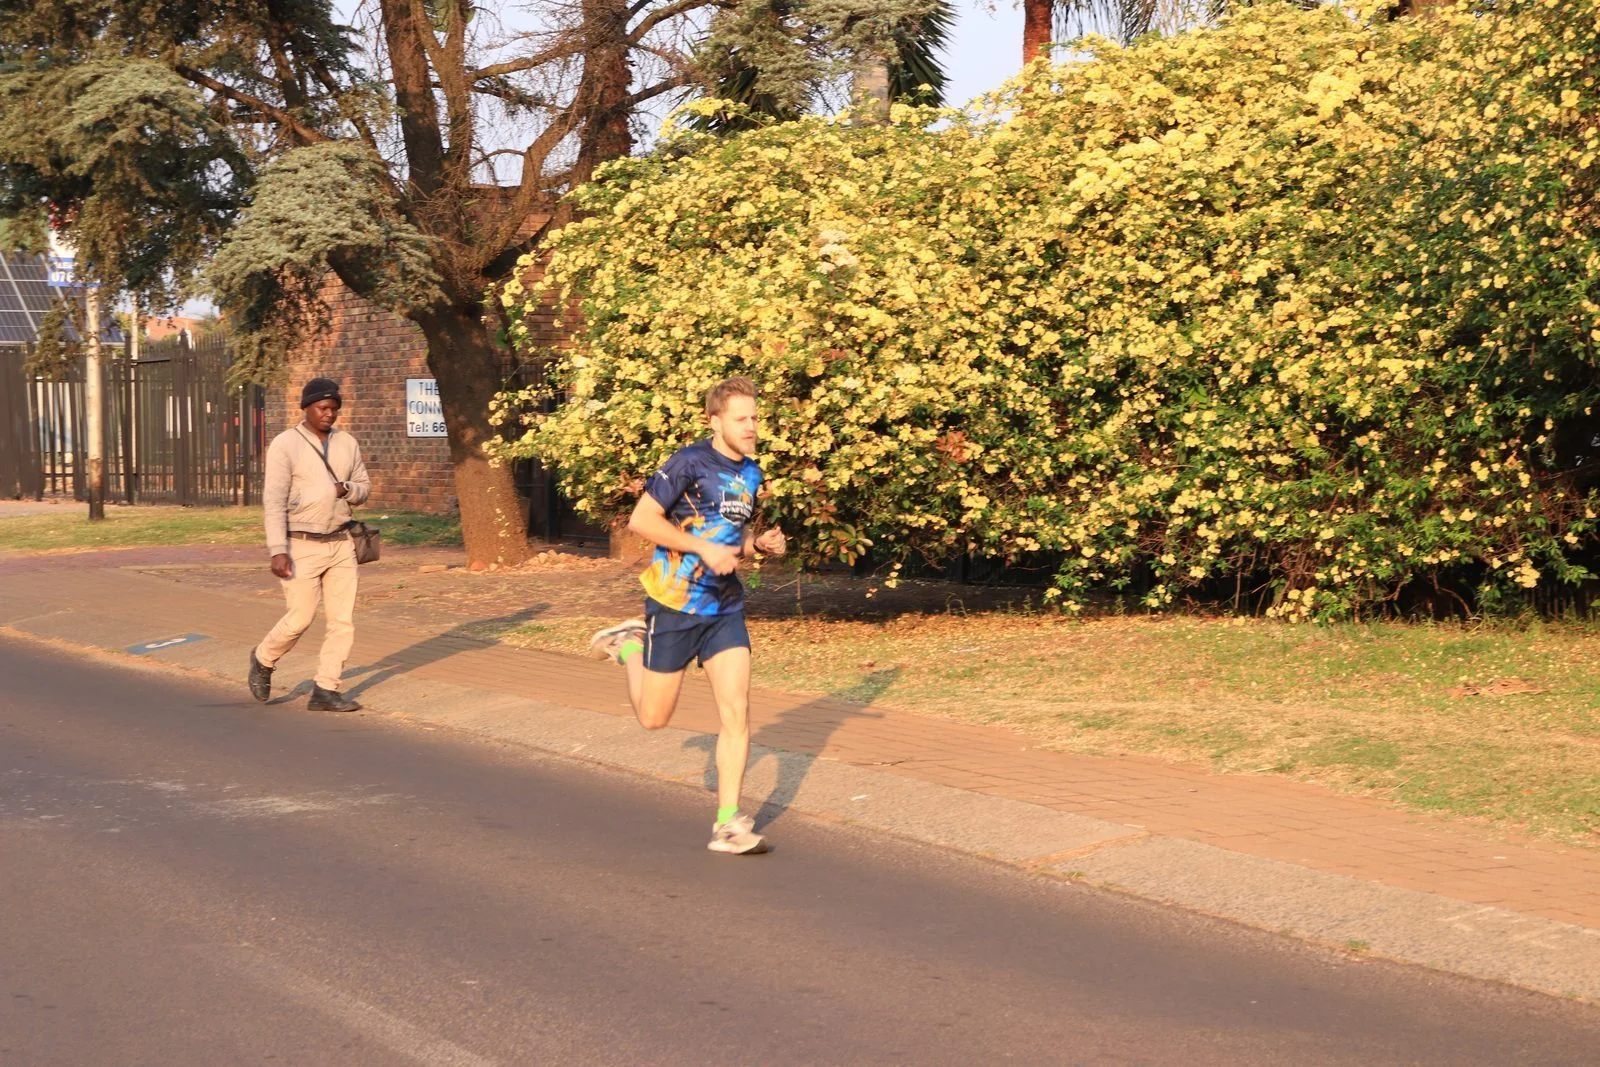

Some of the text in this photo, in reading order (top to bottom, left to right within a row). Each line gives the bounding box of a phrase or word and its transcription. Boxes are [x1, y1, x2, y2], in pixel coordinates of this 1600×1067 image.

[419, 382, 440, 395] THE
[409, 422, 447, 432] Tel: 66
